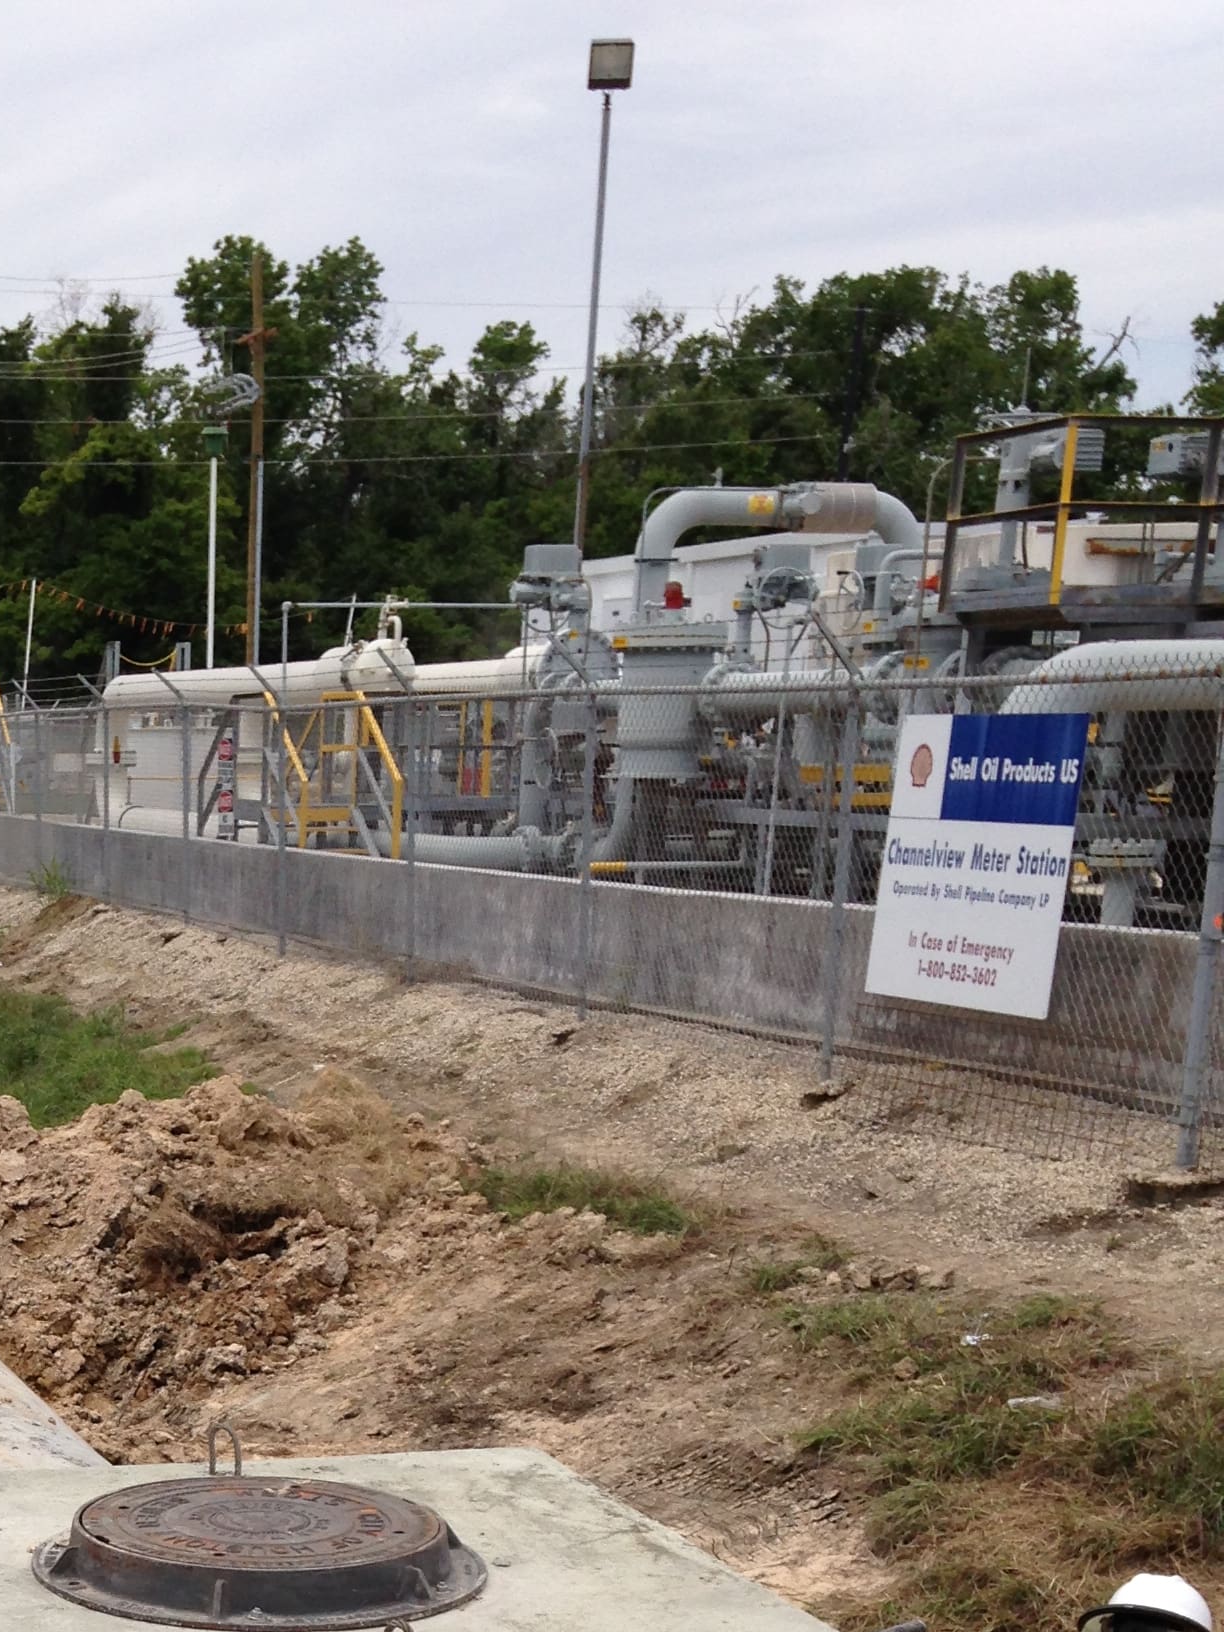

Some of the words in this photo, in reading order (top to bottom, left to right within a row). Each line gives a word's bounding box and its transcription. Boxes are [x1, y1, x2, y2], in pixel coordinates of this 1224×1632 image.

[950, 756, 978, 781] Shell
[981, 757, 999, 782] Oil
[1002, 757, 1056, 783] Products
[1060, 758, 1080, 784] US
[888, 837, 965, 869] Channelview
[971, 843, 1010, 873] Meter
[1017, 845, 1067, 878] Station
[893, 880, 928, 898] Operated
[931, 883, 941, 901] By
[944, 885, 963, 901] Shell
[965, 886, 996, 905] Pipeline
[998, 889, 1037, 911] Company
[1039, 893, 1050, 908] LP
[908, 930, 918, 948] In
[920, 931, 944, 952] Case
[947, 934, 958, 953] of
[960, 937, 1015, 966] Emergency
[918, 959, 998, 987] 1-800-852-3602
